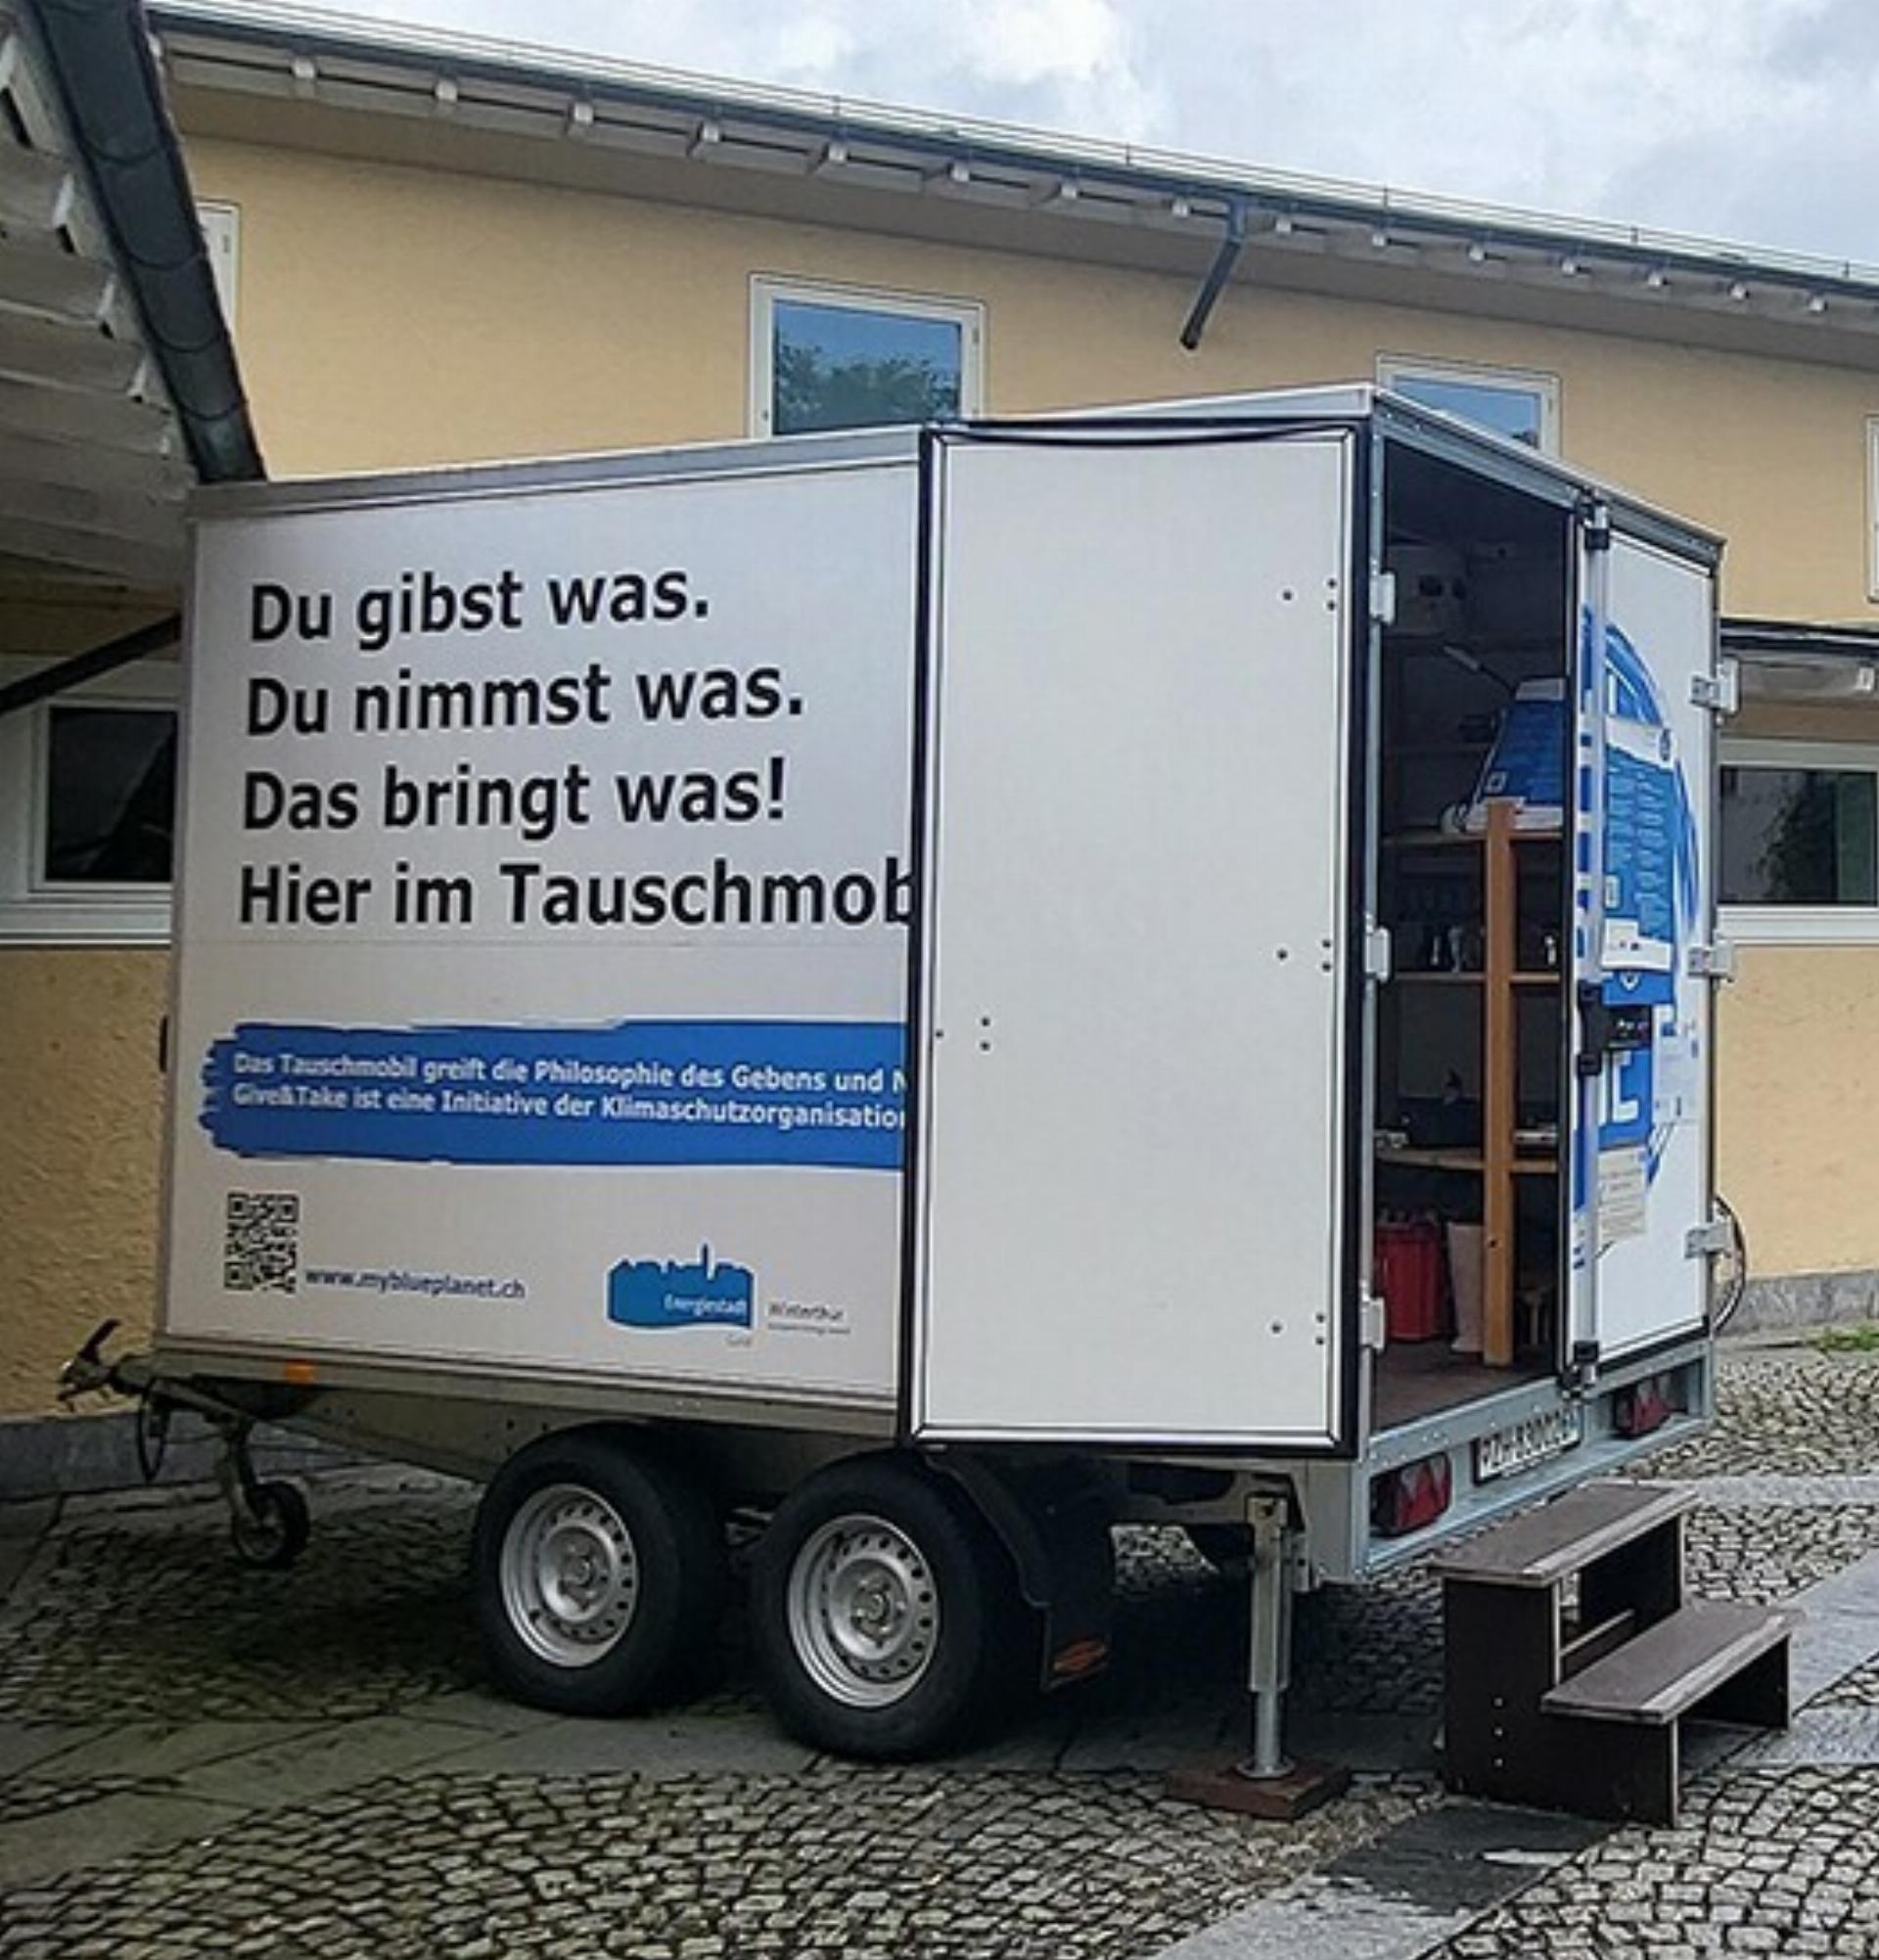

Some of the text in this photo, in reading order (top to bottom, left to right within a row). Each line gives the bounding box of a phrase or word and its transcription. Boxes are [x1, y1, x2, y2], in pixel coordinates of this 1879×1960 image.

[251, 570, 709, 651] Du gibst was.
[248, 664, 802, 736] Du nimmst was.
[244, 757, 785, 840] Das bringt was!
[240, 863, 372, 925] Hier
[394, 861, 473, 924] im
[234, 1053, 274, 1073] Das
[279, 1054, 417, 1076] Tauschmobil
[423, 1056, 486, 1084] greift
[491, 1059, 528, 1082] die
[534, 1060, 674, 1089] Philosophie
[681, 1064, 725, 1088] des
[732, 1064, 827, 1092] Gebens
[835, 1067, 885, 1093] und
[352, 1086, 383, 1110] ist
[388, 1087, 435, 1113] eine
[441, 1090, 548, 1116] Initiative
[553, 1093, 594, 1117] der
